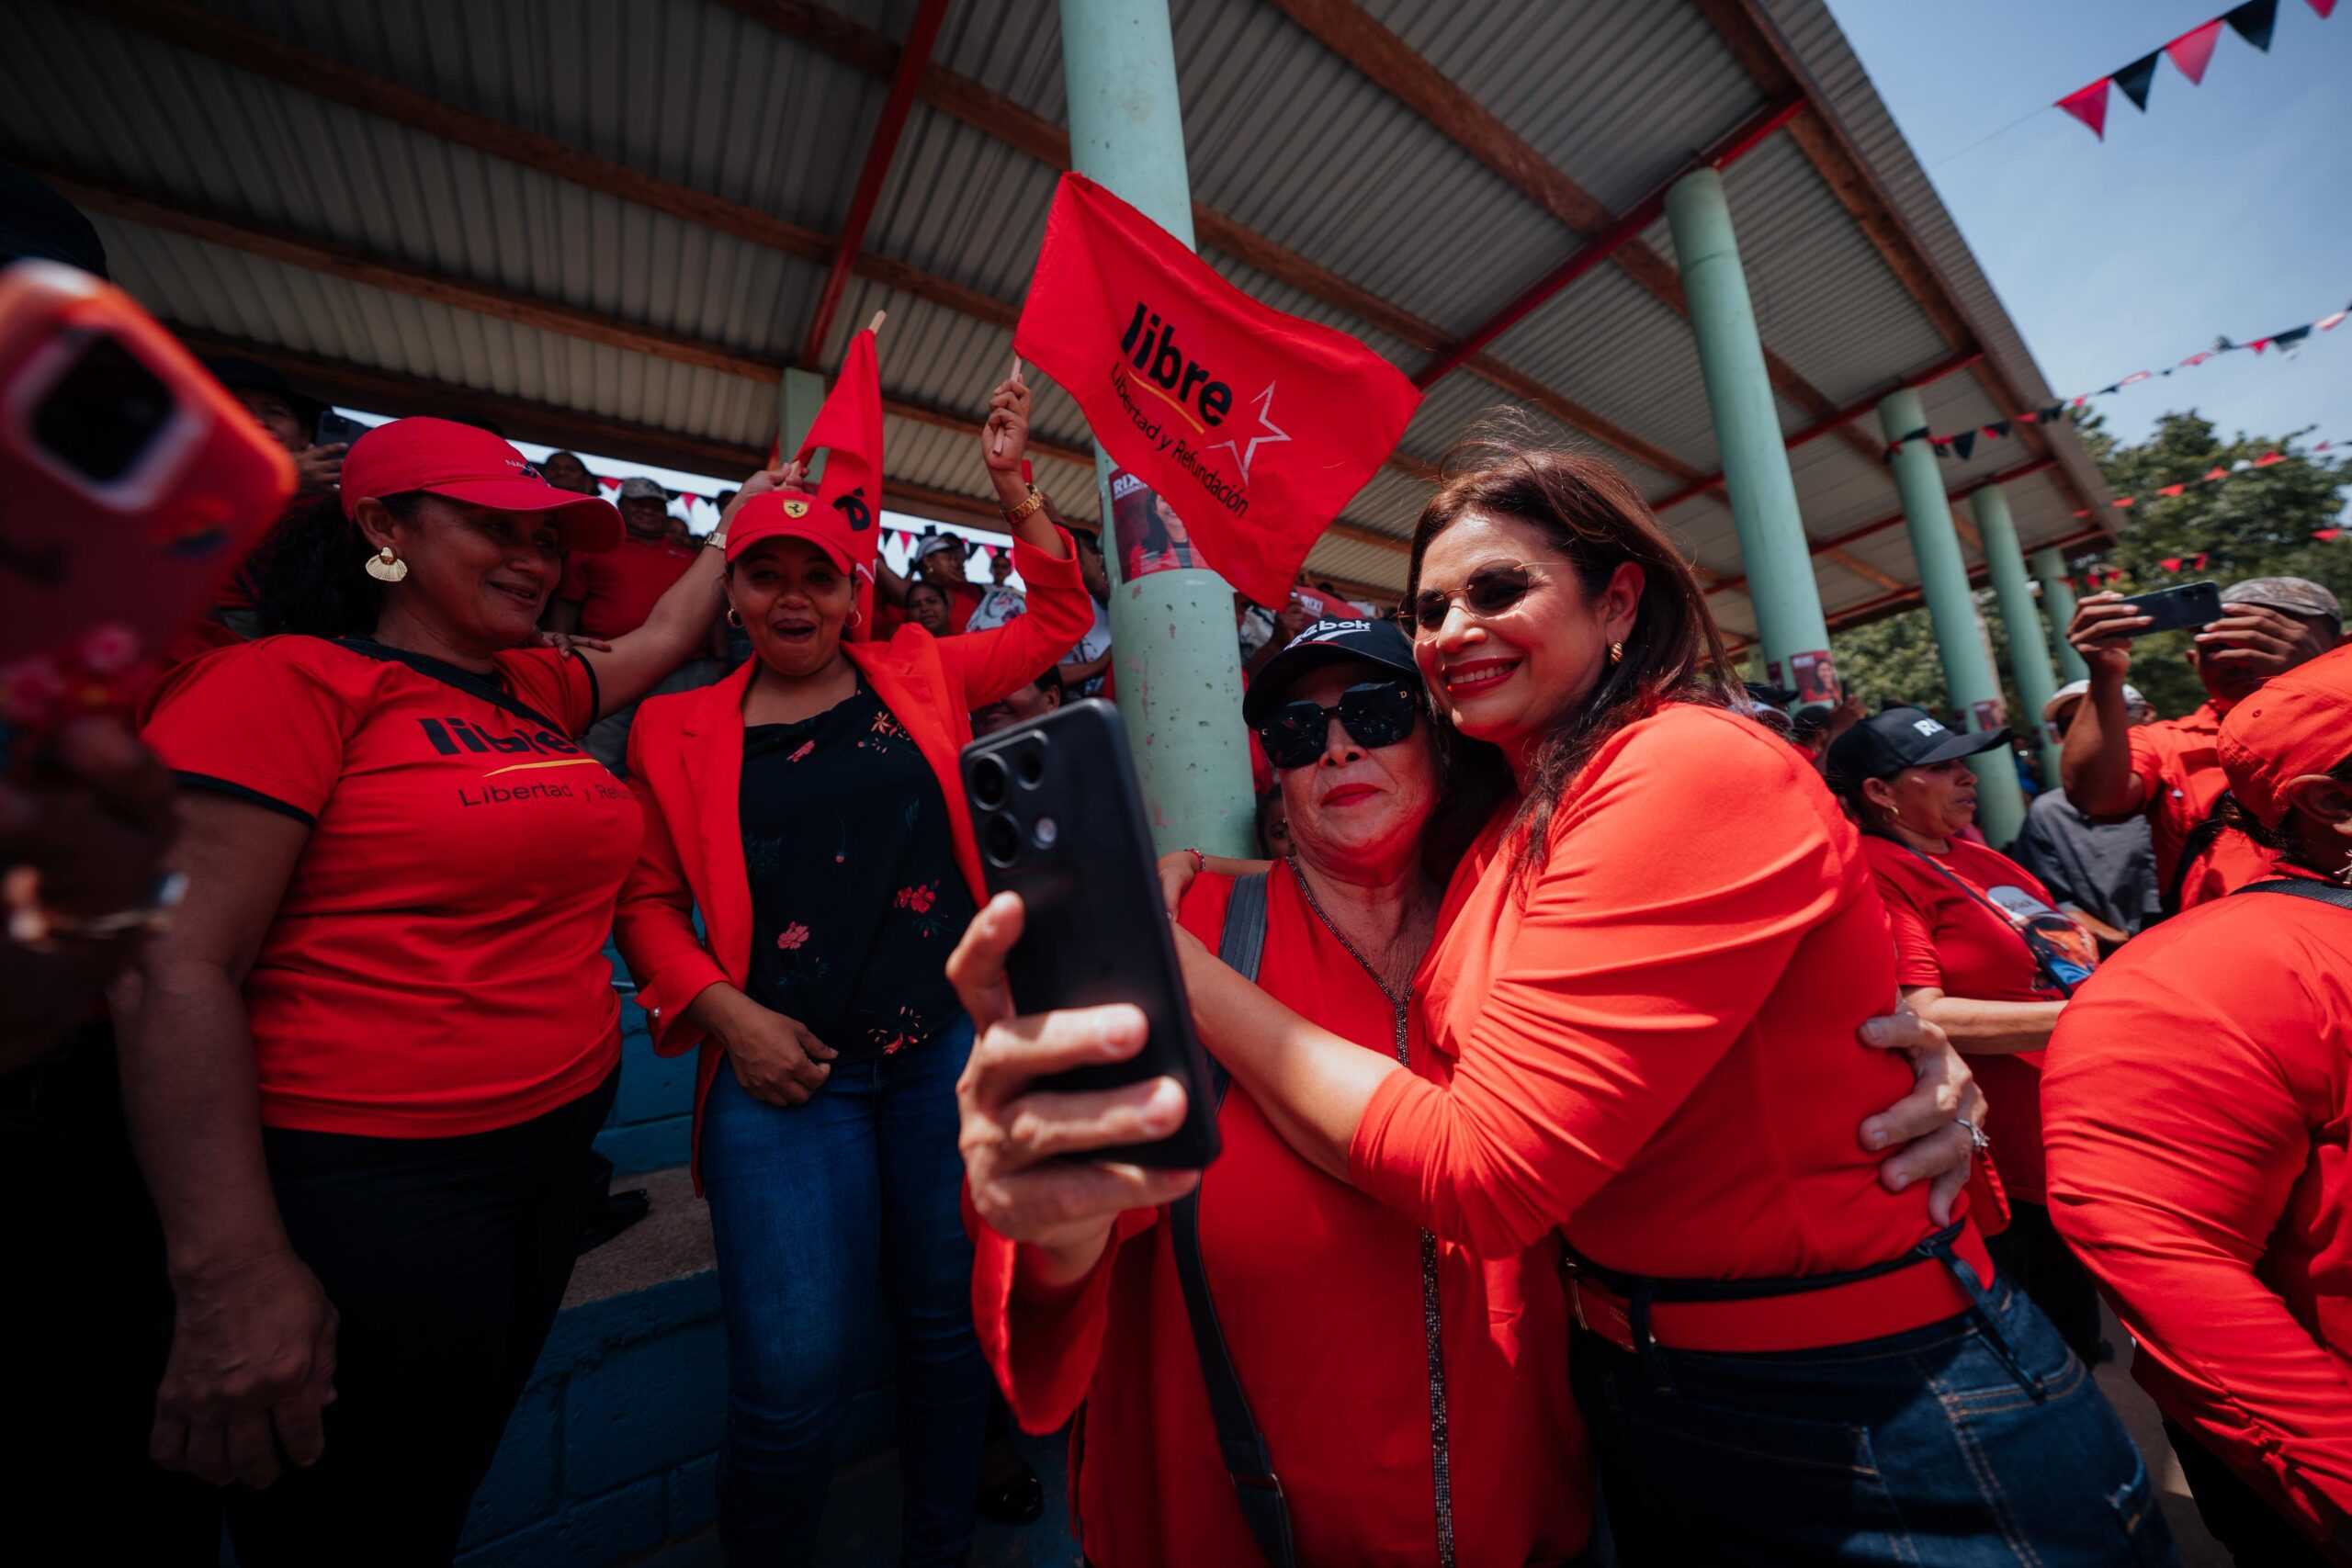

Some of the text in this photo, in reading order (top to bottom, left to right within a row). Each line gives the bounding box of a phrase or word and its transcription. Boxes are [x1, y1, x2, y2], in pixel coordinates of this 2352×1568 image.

[1121, 301, 1233, 427] libre
[1111, 362, 1162, 440] Libertad
[1157, 432, 1173, 452] y
[1171, 440, 1250, 517] Refundación
[1113, 472, 1142, 495] RIX
[416, 717, 580, 756] libre
[458, 782, 573, 807] Libertad
